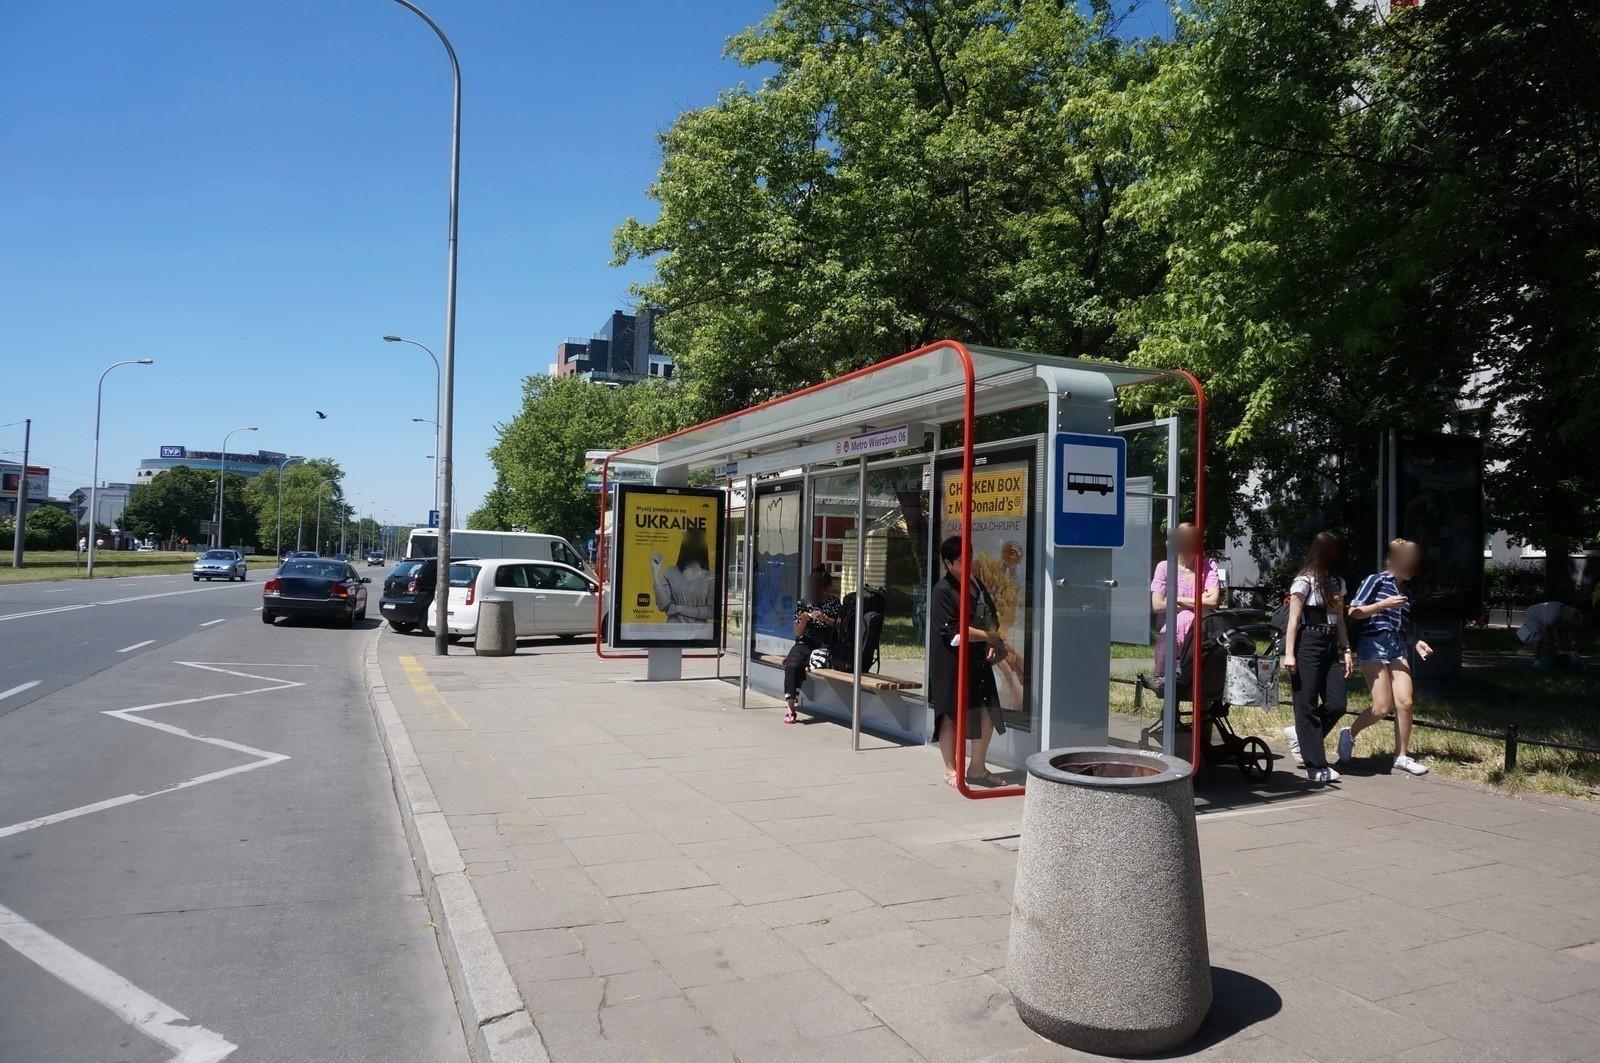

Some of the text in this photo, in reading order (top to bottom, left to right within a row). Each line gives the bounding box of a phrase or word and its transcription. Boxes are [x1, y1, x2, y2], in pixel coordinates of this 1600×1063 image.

[850, 441, 868, 452] Metro
[869, 435, 897, 448] Wierzbno
[949, 476, 1021, 497] CHKEN BOX
[947, 504, 954, 514] z
[635, 513, 707, 530] UKRAINE
[989, 520, 1021, 532] CHRUPIE
